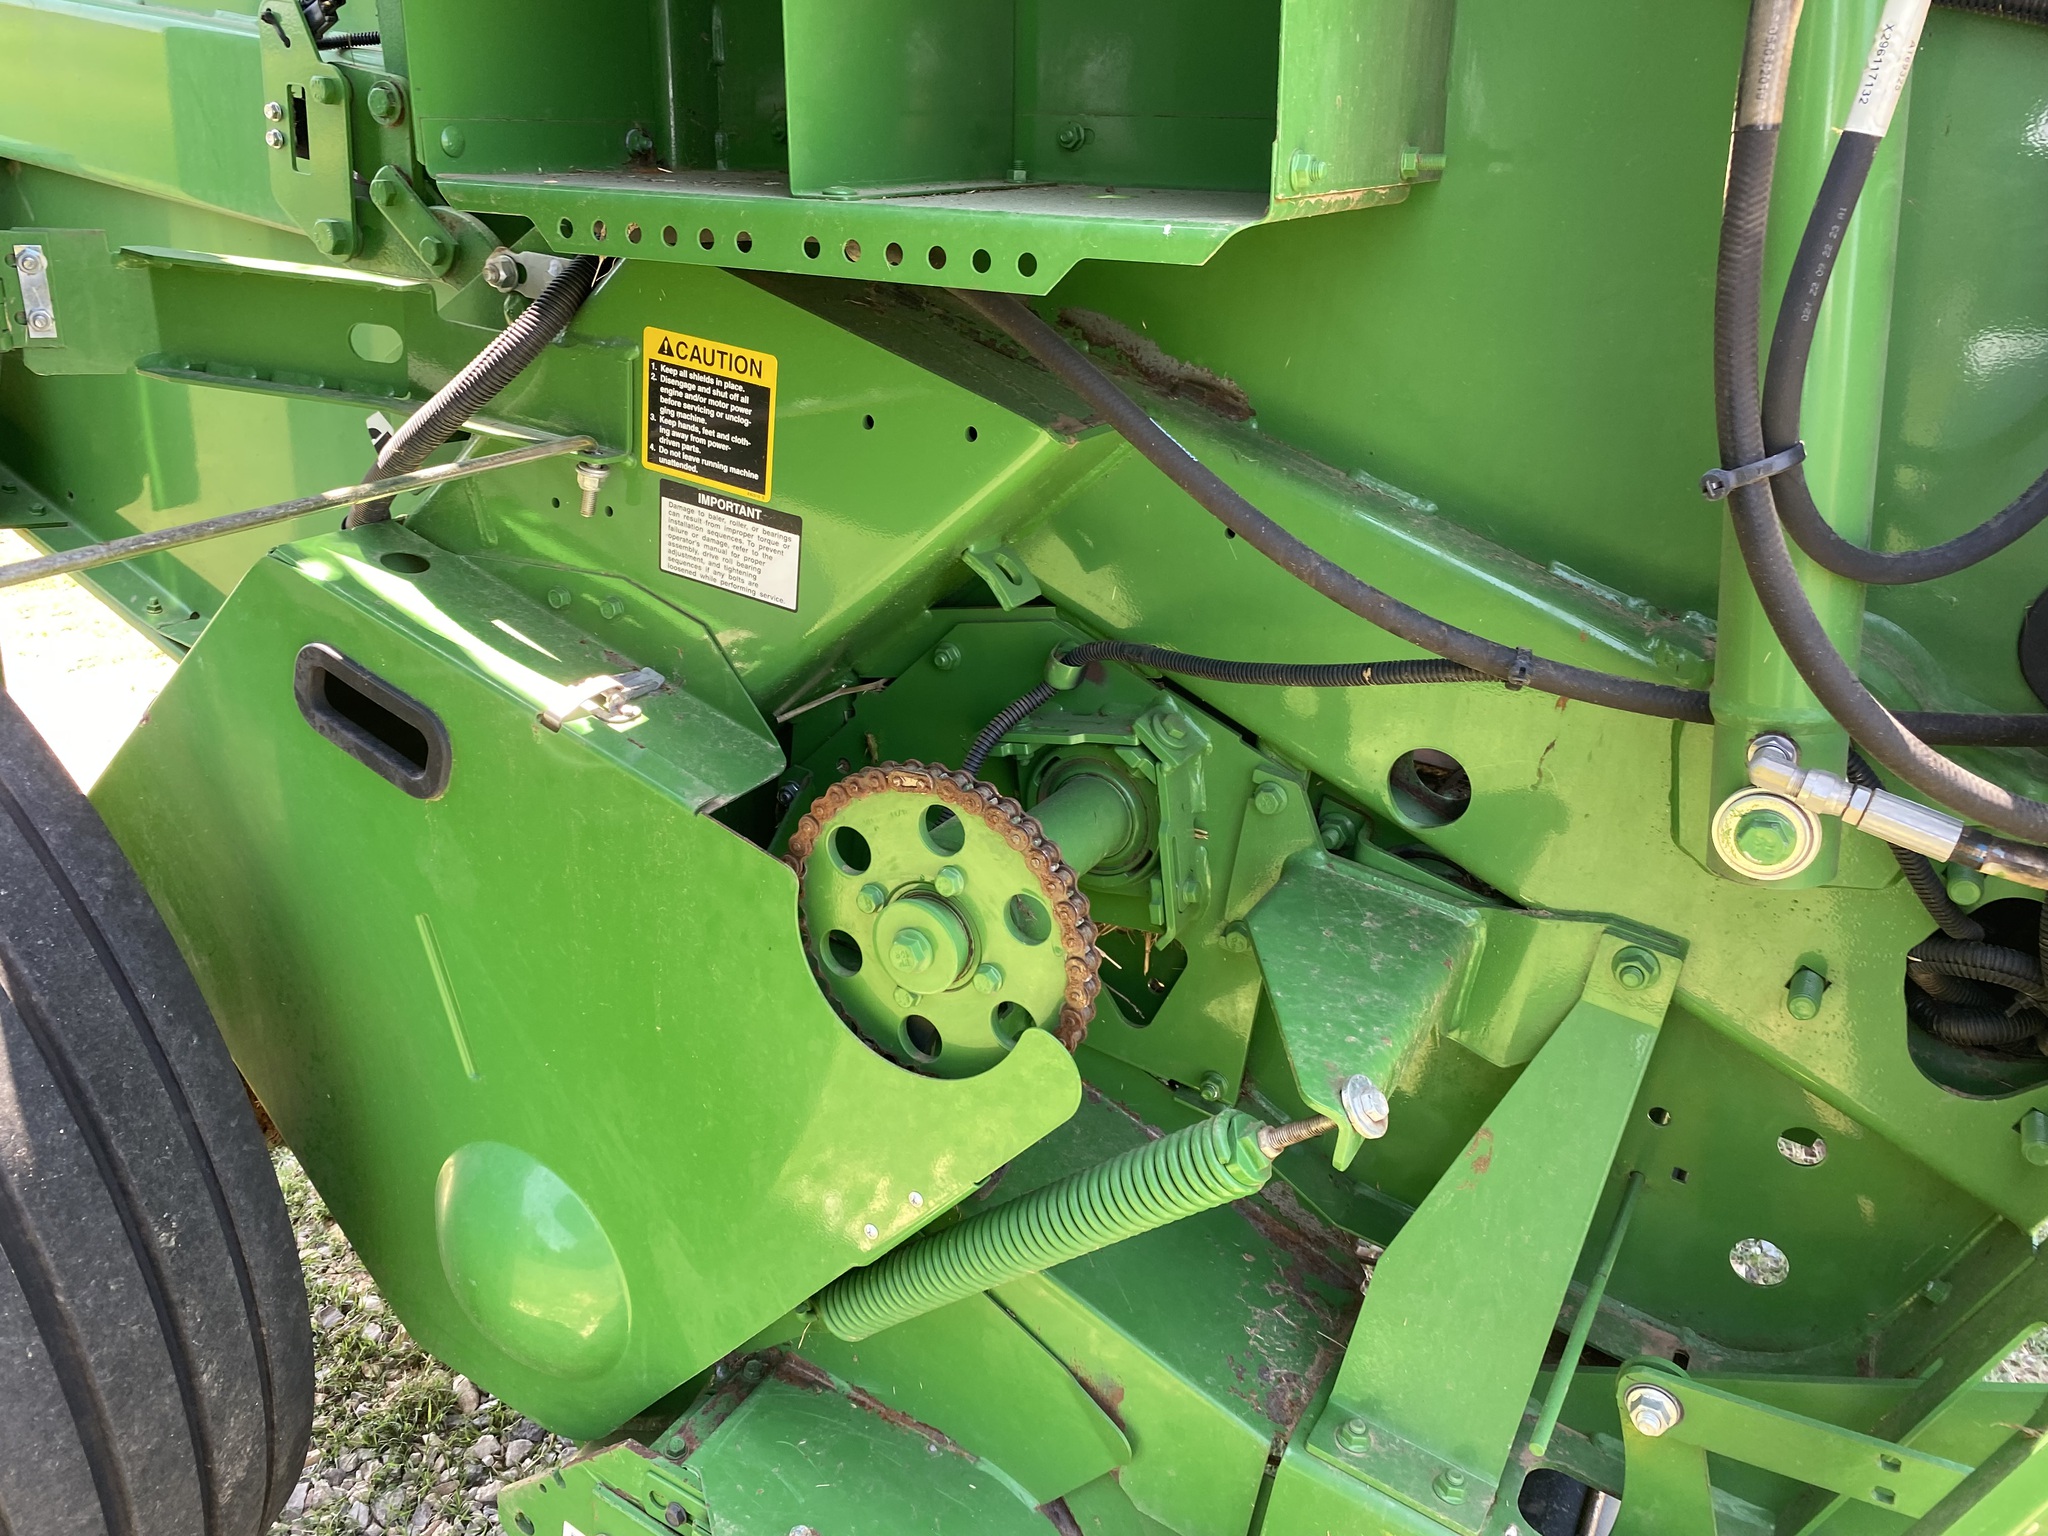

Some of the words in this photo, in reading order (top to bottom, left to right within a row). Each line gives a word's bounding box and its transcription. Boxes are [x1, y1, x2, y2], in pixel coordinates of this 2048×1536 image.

[1858, 23, 1895, 105] X296117132
[675, 341, 763, 379] CAUTION
[650, 372, 658, 381] 2.
[660, 374, 696, 391] Disengage
[697, 385, 711, 394] and
[712, 388, 728, 399] shut
[729, 392, 740, 401] off
[740, 396, 749, 404] all
[651, 362, 658, 371] 1.
[660, 364, 678, 377] Keep
[679, 370, 688, 378] all
[689, 372, 715, 385] shields
[715, 377, 723, 387] in
[723, 381, 745, 393] place.
[660, 386, 684, 398] engine
[684, 392, 707, 404] and/or
[708, 398, 729, 409] motor
[730, 404, 753, 416] power
[660, 395, 682, 408] before
[682, 402, 715, 418] servicing
[715, 411, 724, 419] or
[724, 413, 752, 427] unclog-
[660, 406, 675, 418] ging
[676, 410, 707, 425] machine.
[650, 413, 657, 421] 3.
[660, 415, 677, 428] Keep
[677, 420, 701, 434] hands,
[702, 426, 716, 437] feet
[716, 431, 730, 441] and
[730, 435, 751, 446] cloth-
[659, 425, 670, 437] ing
[671, 430, 689, 442] away
[690, 434, 706, 445] from
[707, 440, 732, 451] power-
[659, 436, 680, 448] driven
[681, 443, 701, 454] parts.
[650, 443, 656, 451] 4.
[658, 445, 669, 455] Do
[670, 450, 681, 458] not
[682, 452, 700, 464] leave
[701, 458, 728, 473] running
[729, 466, 759, 480] machine
[658, 457, 699, 473] unattended.
[669, 501, 695, 515] Damage
[730, 520, 748, 530] roller,
[762, 528, 792, 542] bearings
[698, 493, 762, 520] IMPORTANT
[668, 510, 680, 518] can
[683, 514, 702, 524] result
[705, 520, 721, 530] from
[724, 524, 754, 539] improper
[757, 535, 779, 547] torque
[668, 516, 704, 532] installation
[707, 529, 744, 545] sequences.
[747, 540, 755, 548] To
[758, 544, 784, 557] prevent
[668, 524, 688, 535] failure
[702, 535, 730, 549] damage,
[732, 544, 749, 554] refer
[751, 549, 759, 557] to
[762, 552, 773, 561] the
[667, 533, 700, 547] operator's
[704, 544, 727, 555] manual
[730, 551, 741, 559] for
[743, 556, 766, 567] proper
[702, 551, 719, 560] drive
[722, 557, 733, 565] roll
[736, 560, 762, 574] bearing
[668, 556, 702, 571] sequences
[713, 570, 725, 579] any
[728, 573, 745, 584] bolts
[748, 580, 759, 588] are
[668, 563, 697, 577] loosened
[700, 573, 717, 583] while
[720, 580, 756, 596] performing
[708, 560, 721, 569] and
[723, 565, 757, 581] tightening
